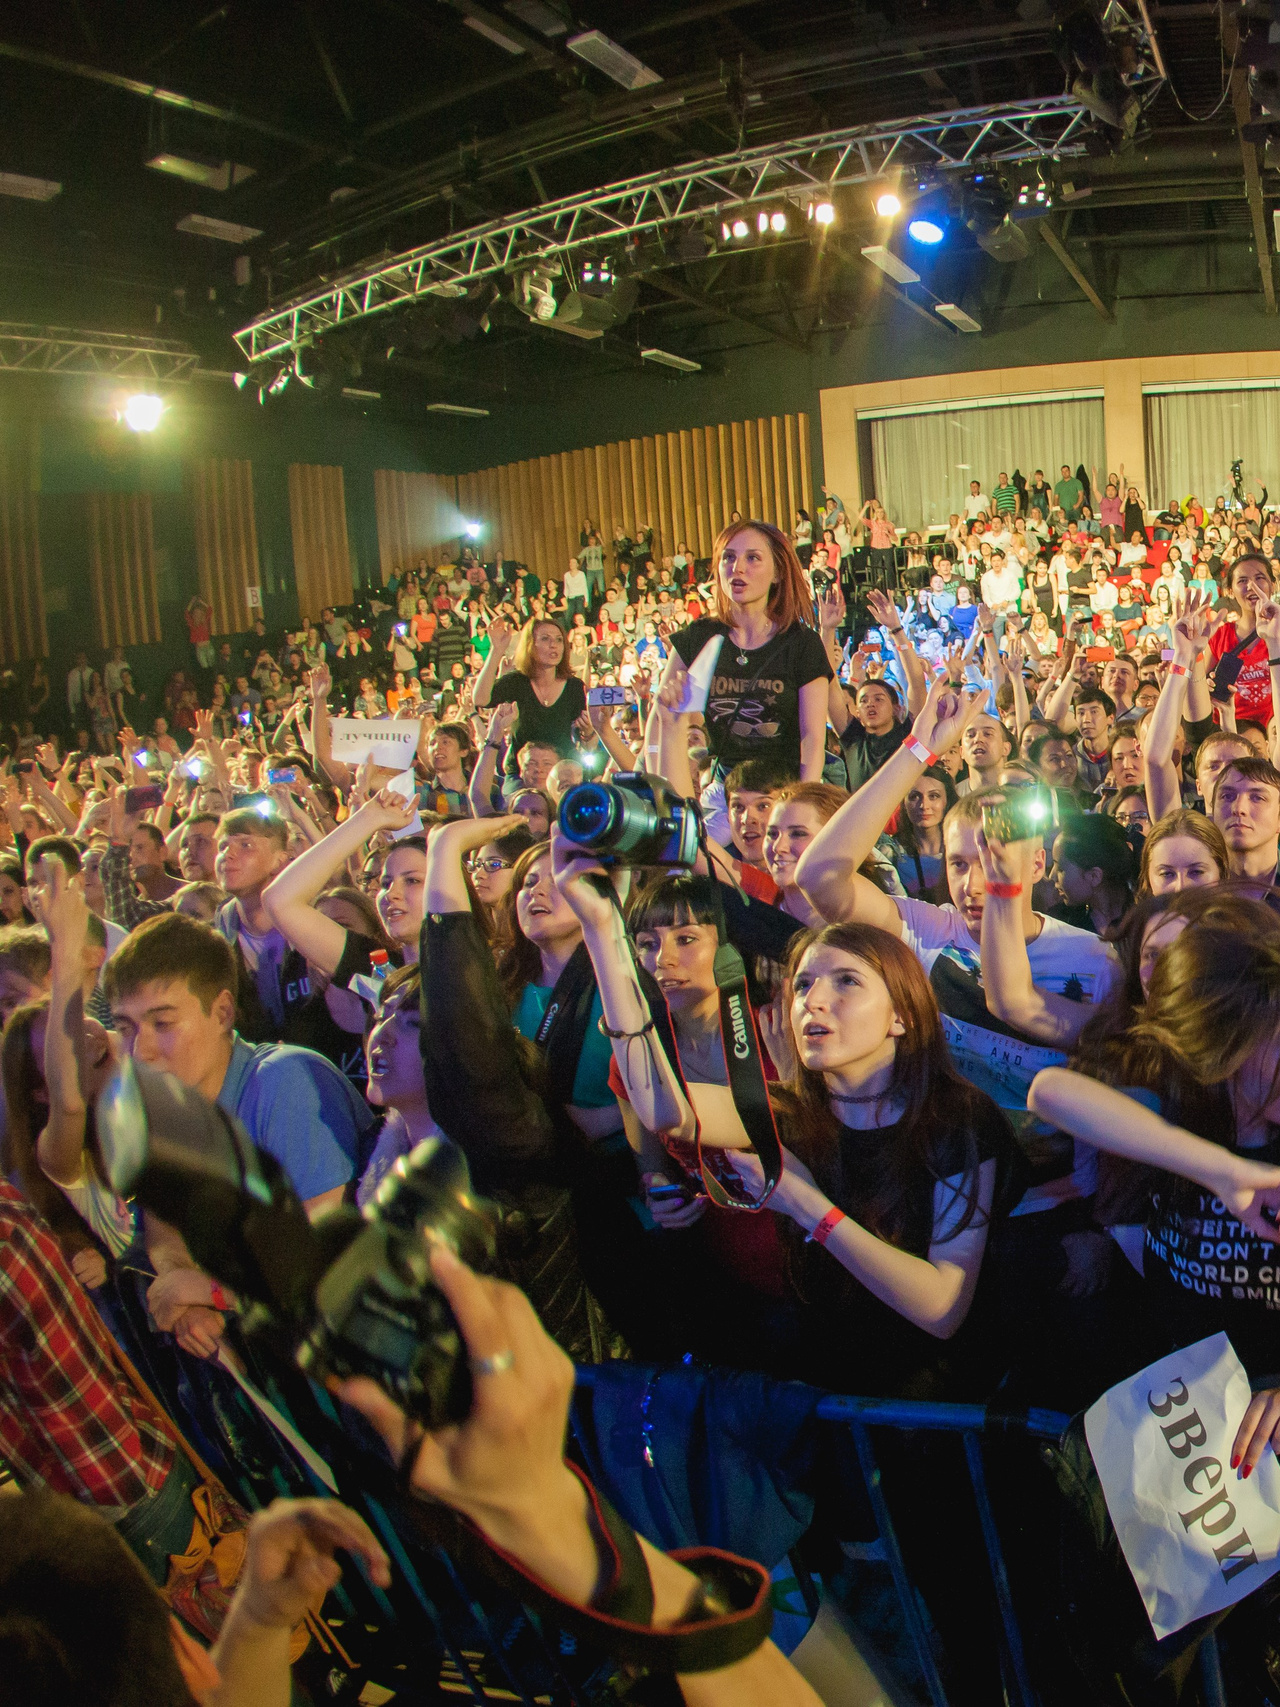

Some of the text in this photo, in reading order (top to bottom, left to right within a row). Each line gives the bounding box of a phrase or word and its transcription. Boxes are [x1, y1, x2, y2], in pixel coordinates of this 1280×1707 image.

[340, 731, 411, 744] лучшие
[538, 1002, 559, 1041] Canon
[728, 994, 750, 1059] Canon
[990, 1046, 1023, 1067] AND
[1199, 1241, 1275, 1262] DON'T
[1168, 1266, 1223, 1299] YOUR
[1172, 1252, 1250, 1284] WORLD
[1146, 1375, 1260, 1586] звери
